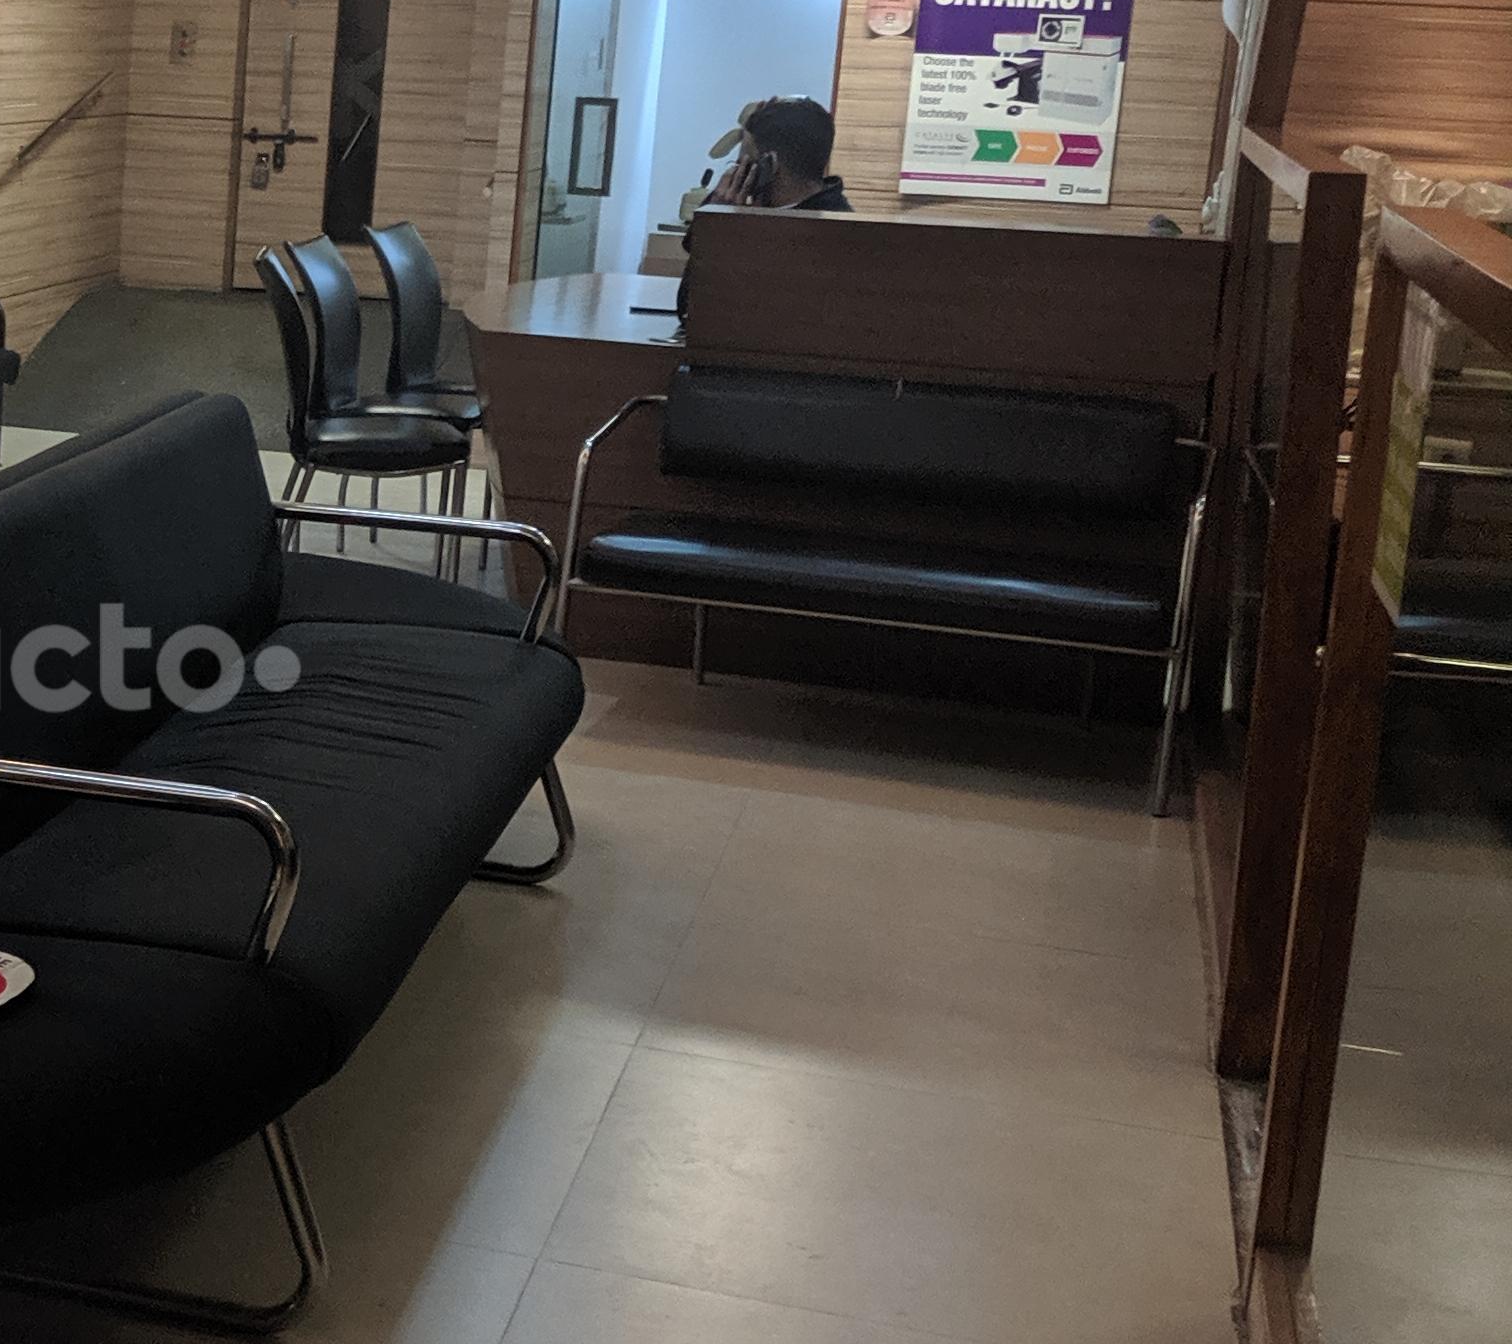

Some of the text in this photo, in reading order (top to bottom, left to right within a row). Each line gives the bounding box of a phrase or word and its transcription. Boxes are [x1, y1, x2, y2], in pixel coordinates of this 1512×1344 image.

[923, 56, 974, 67] Choose the
[921, 69, 977, 81] latest 100%
[920, 82, 967, 93] blade free
[918, 95, 943, 105] laser
[917, 108, 969, 122] technology
